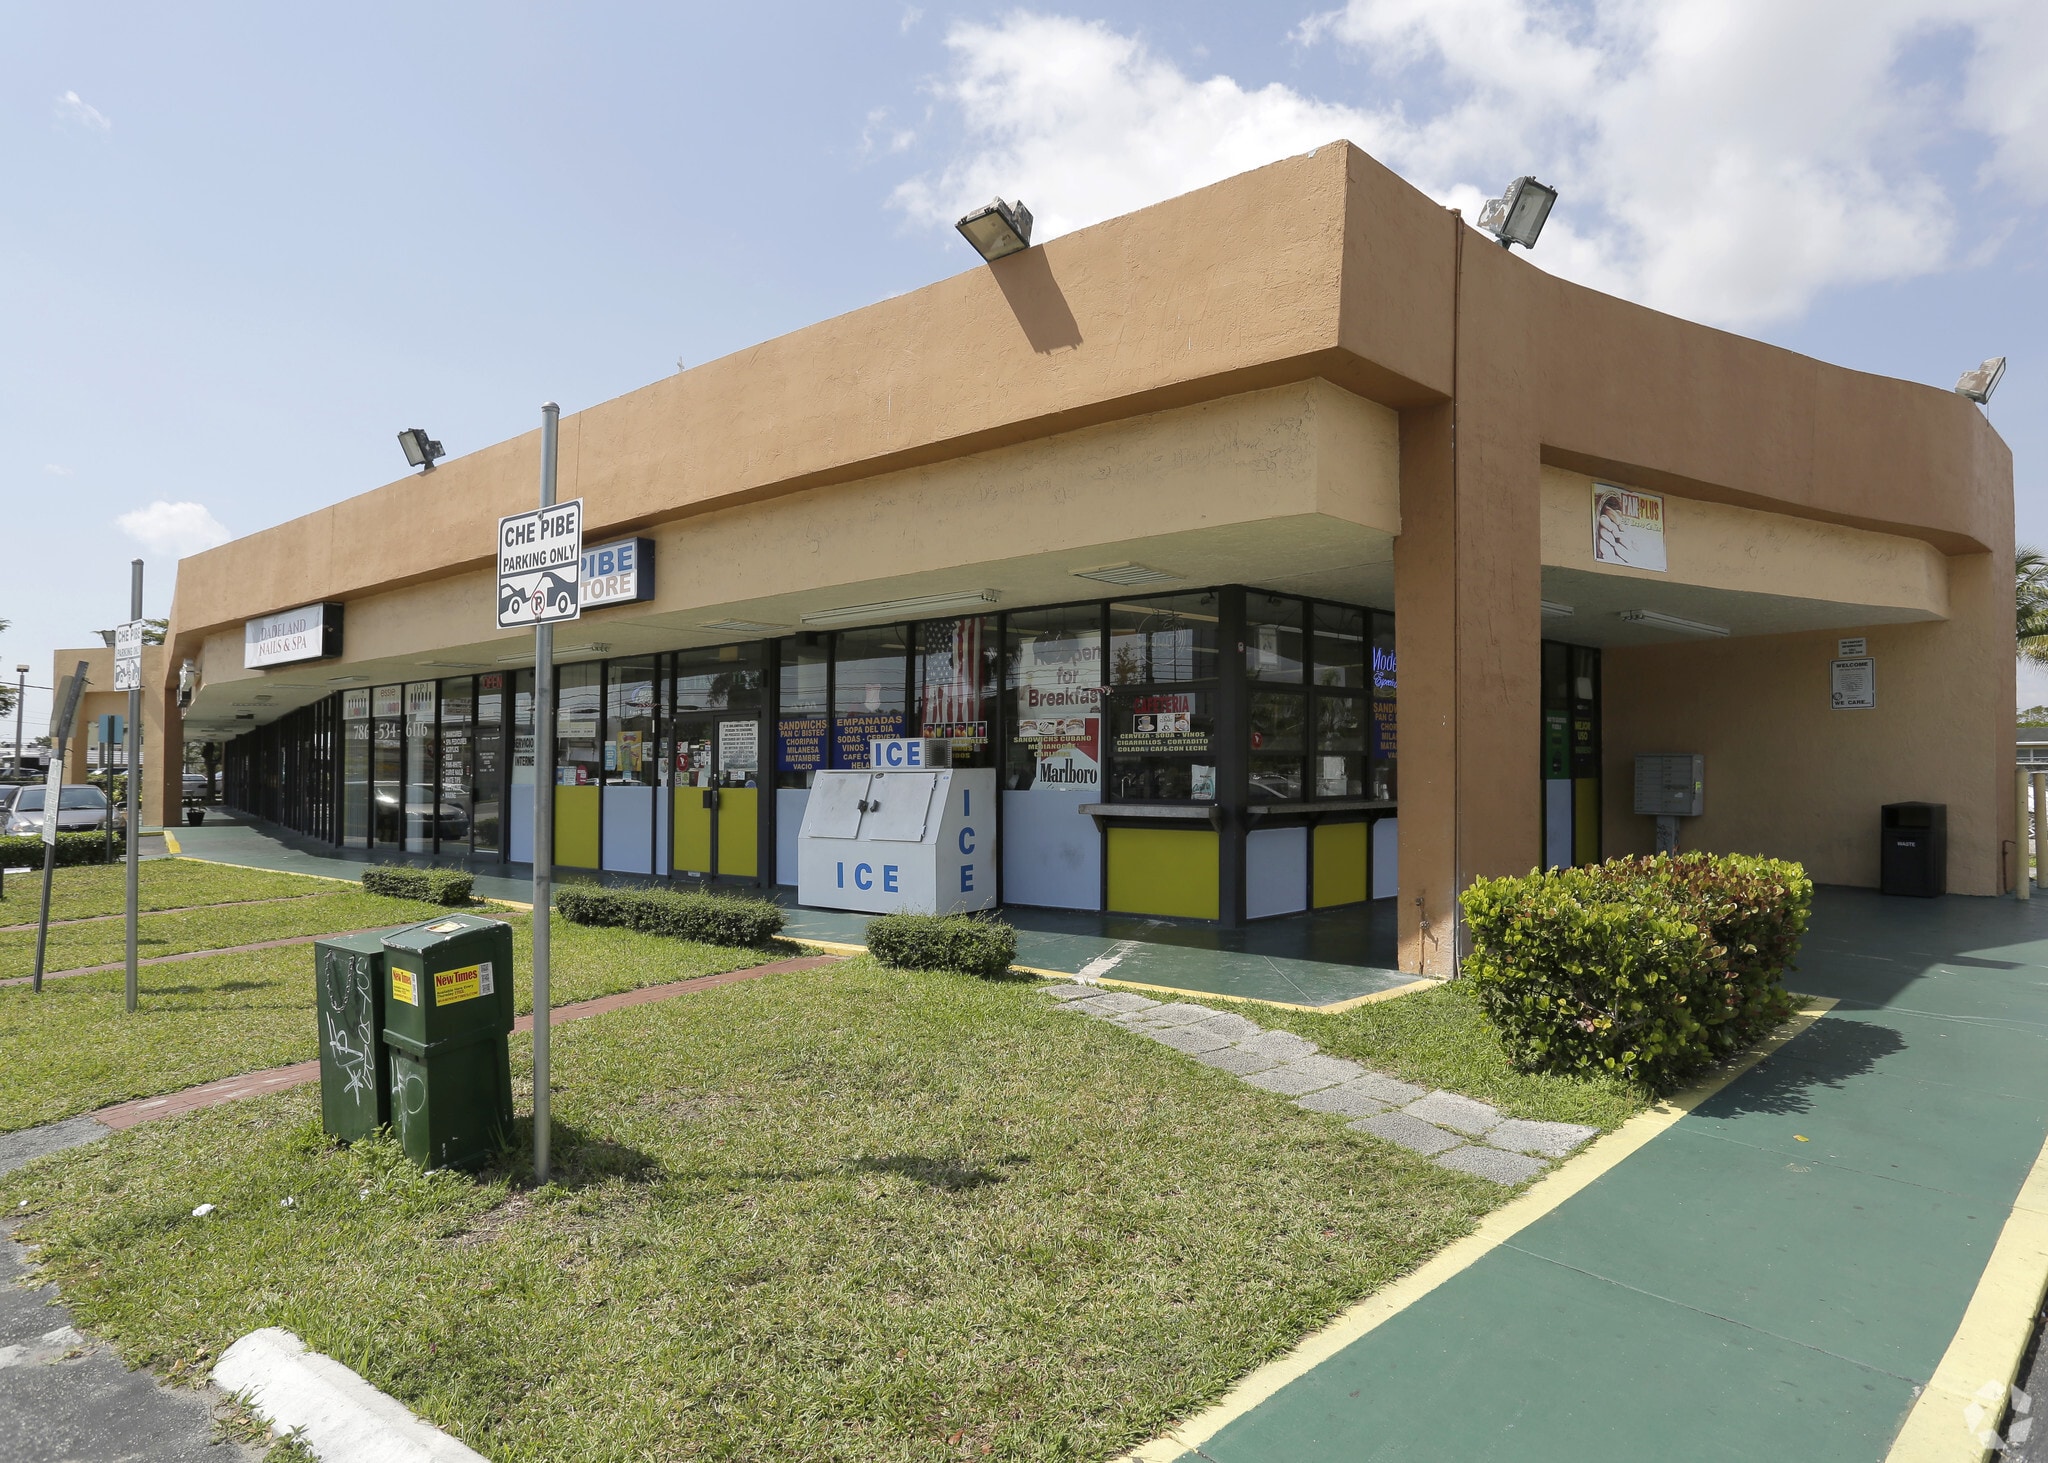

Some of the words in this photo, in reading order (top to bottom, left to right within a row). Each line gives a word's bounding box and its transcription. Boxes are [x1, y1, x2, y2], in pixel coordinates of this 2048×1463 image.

[1640, 498, 1659, 521] PLUS
[505, 522, 536, 548] CHE
[540, 512, 575, 540] PIBE
[503, 550, 547, 573] PARKING
[550, 543, 576, 566] ONLY
[581, 572, 631, 599] TORE
[118, 629, 129, 643] CHE
[260, 619, 307, 641] DADELAND
[259, 640, 282, 657] NAILS
[283, 638, 291, 652] &
[291, 635, 307, 650] SPA
[482, 675, 503, 689] OPEN
[1057, 666, 1079, 685] for
[380, 688, 396, 697] essie
[1029, 686, 1098, 708] Breakfas
[1134, 695, 1189, 714] CAFETERIA
[779, 719, 828, 731] SANDWICHS
[836, 715, 903, 727] EMPANADAS
[780, 730, 792, 738] PAN
[801, 729, 825, 737] BISTEC
[844, 726, 863, 734] SOPA
[864, 725, 879, 733] DEL
[880, 725, 894, 733] DIA
[515, 737, 534, 749] ERVICIO
[786, 737, 819, 746] CHORIPAN
[837, 735, 861, 744] SODAS
[1013, 735, 1059, 743] SANDWICHS
[787, 746, 819, 754] MILANESA
[842, 744, 865, 752] VINOS
[875, 741, 921, 767] ICE
[514, 755, 535, 767] INTERNE
[785, 754, 821, 762] MATAMBRE
[1040, 758, 1098, 784] Marlboro
[958, 789, 976, 893] ICE
[836, 861, 899, 893] ICE
[436, 974, 455, 987] New
[453, 969, 478, 983] Times
